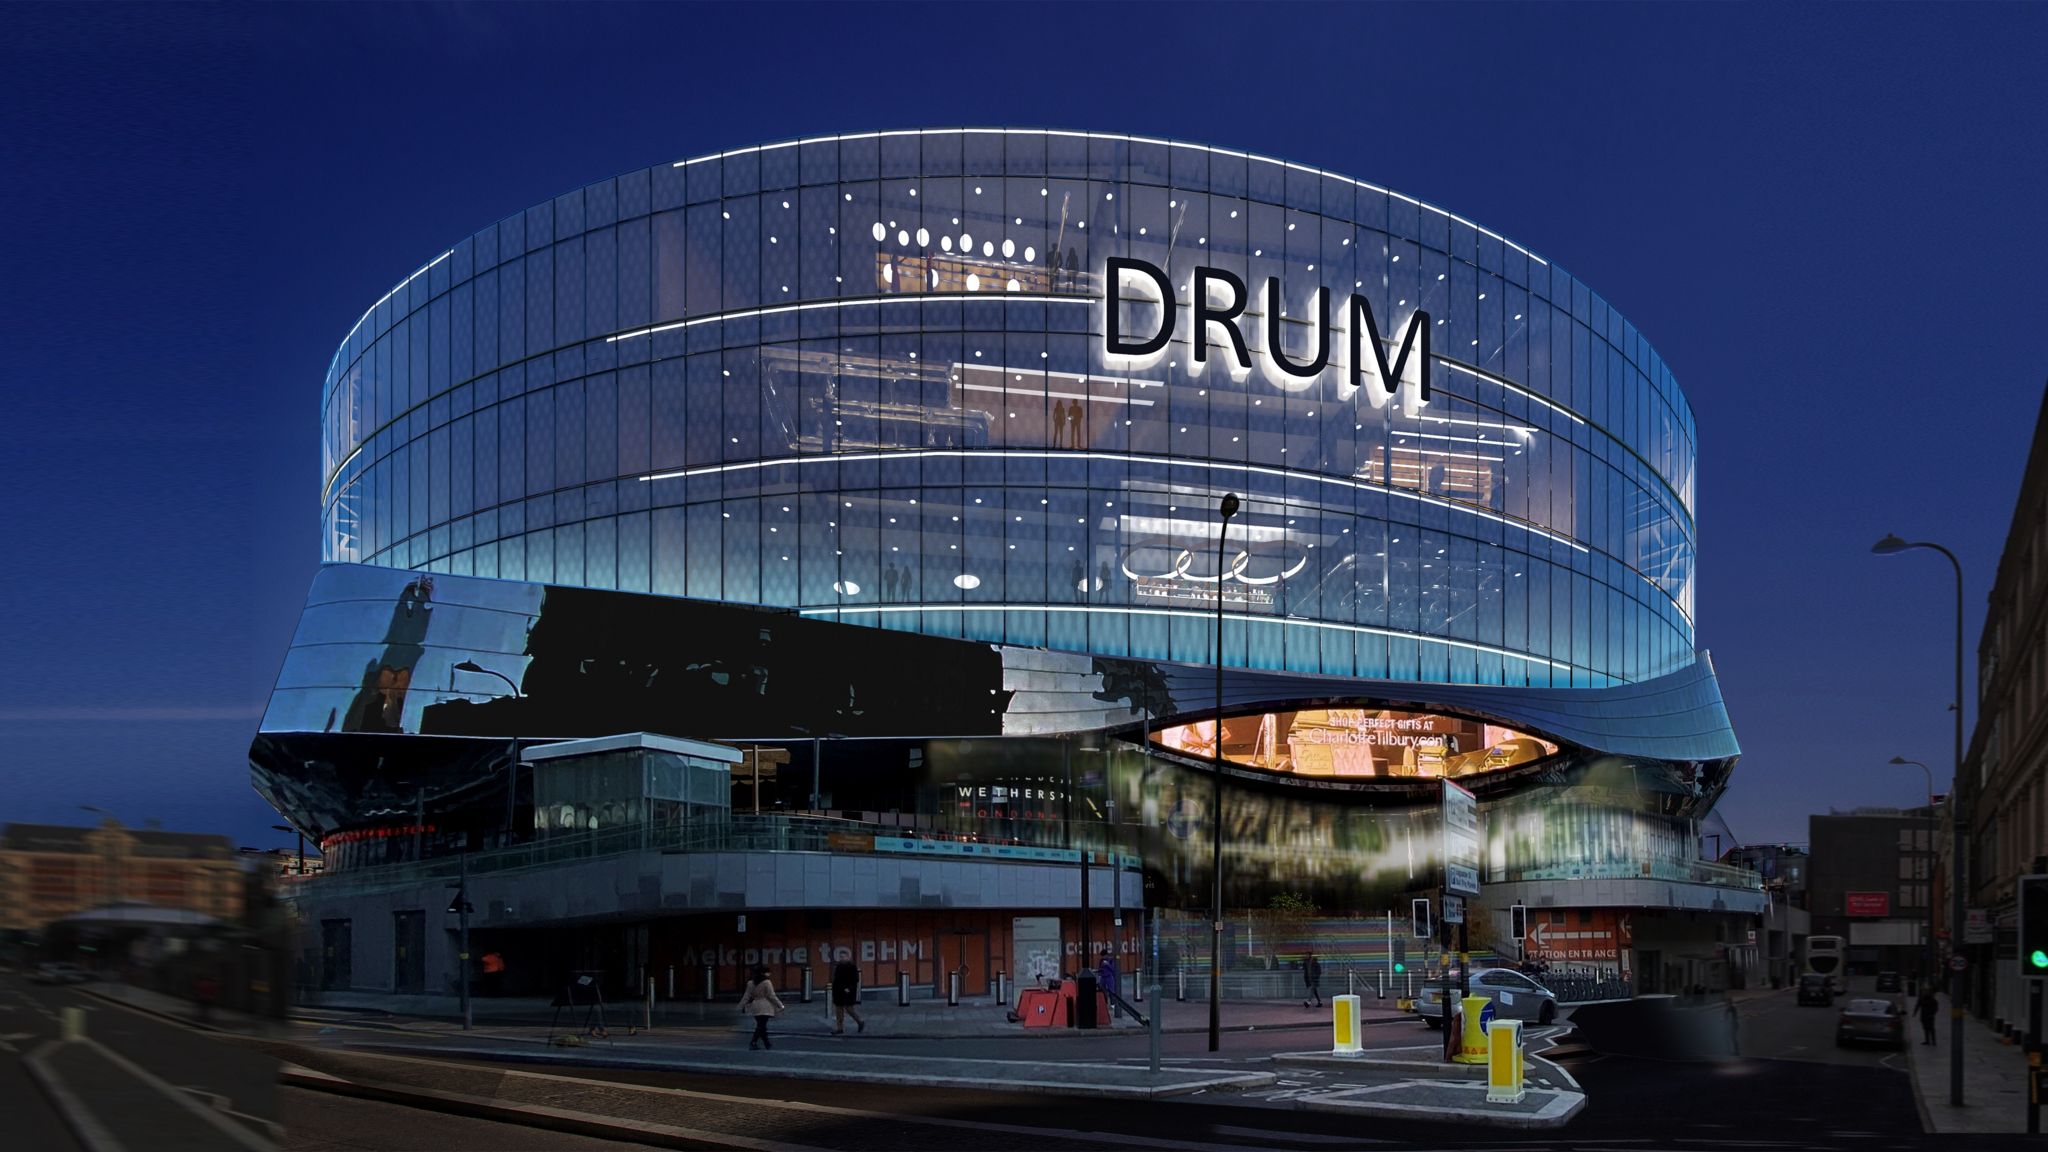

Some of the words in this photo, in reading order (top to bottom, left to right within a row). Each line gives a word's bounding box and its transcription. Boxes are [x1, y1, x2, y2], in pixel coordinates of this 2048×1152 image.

[1106, 256, 1431, 402] DRUM
[1358, 717, 1394, 729] PERFECT
[1397, 719, 1422, 730] GIFTS
[1423, 720, 1434, 731] AT
[682, 943, 808, 966] Welcome
[819, 942, 853, 963] to
[861, 940, 923, 961] BHM
